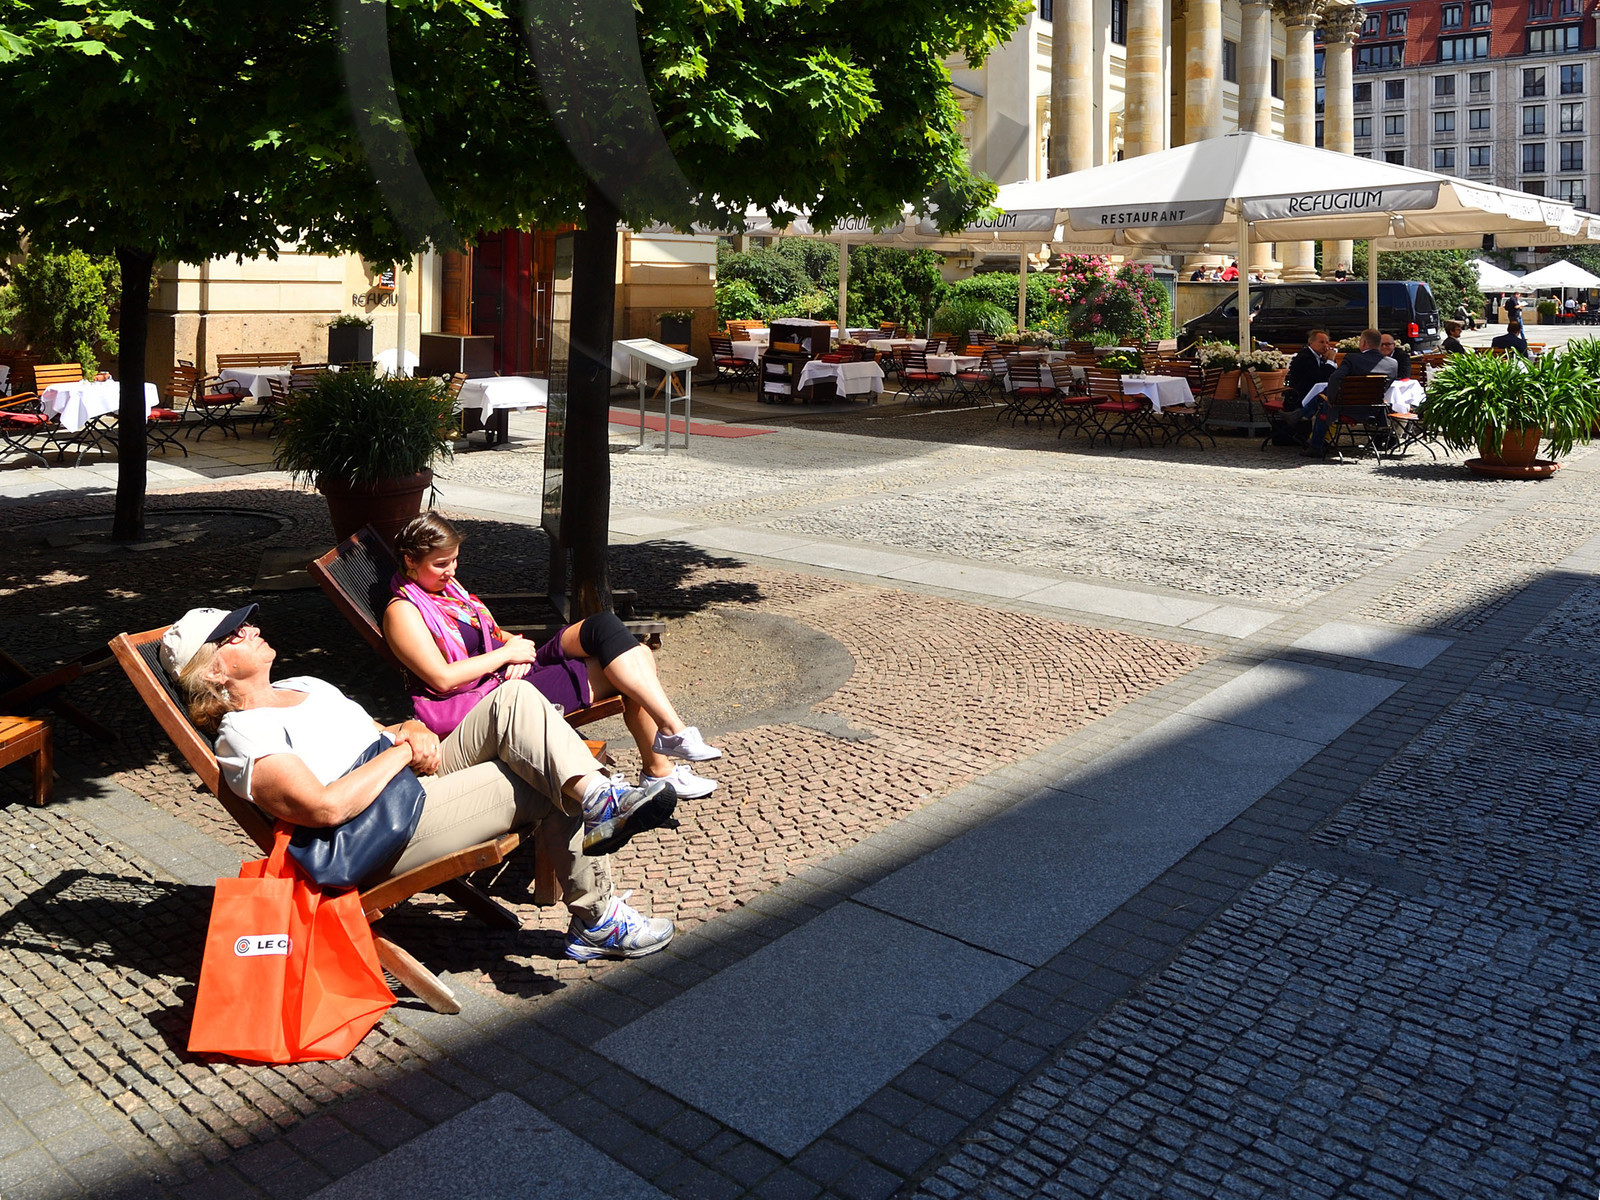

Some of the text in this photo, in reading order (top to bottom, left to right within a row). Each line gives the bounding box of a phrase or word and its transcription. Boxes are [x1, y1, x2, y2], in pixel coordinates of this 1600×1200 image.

[1288, 189, 1384, 214] REFUGIUM
[1101, 209, 1186, 225] RESTAURANT
[352, 292, 398, 307] REFUGIU
[257, 940, 274, 950] LE
